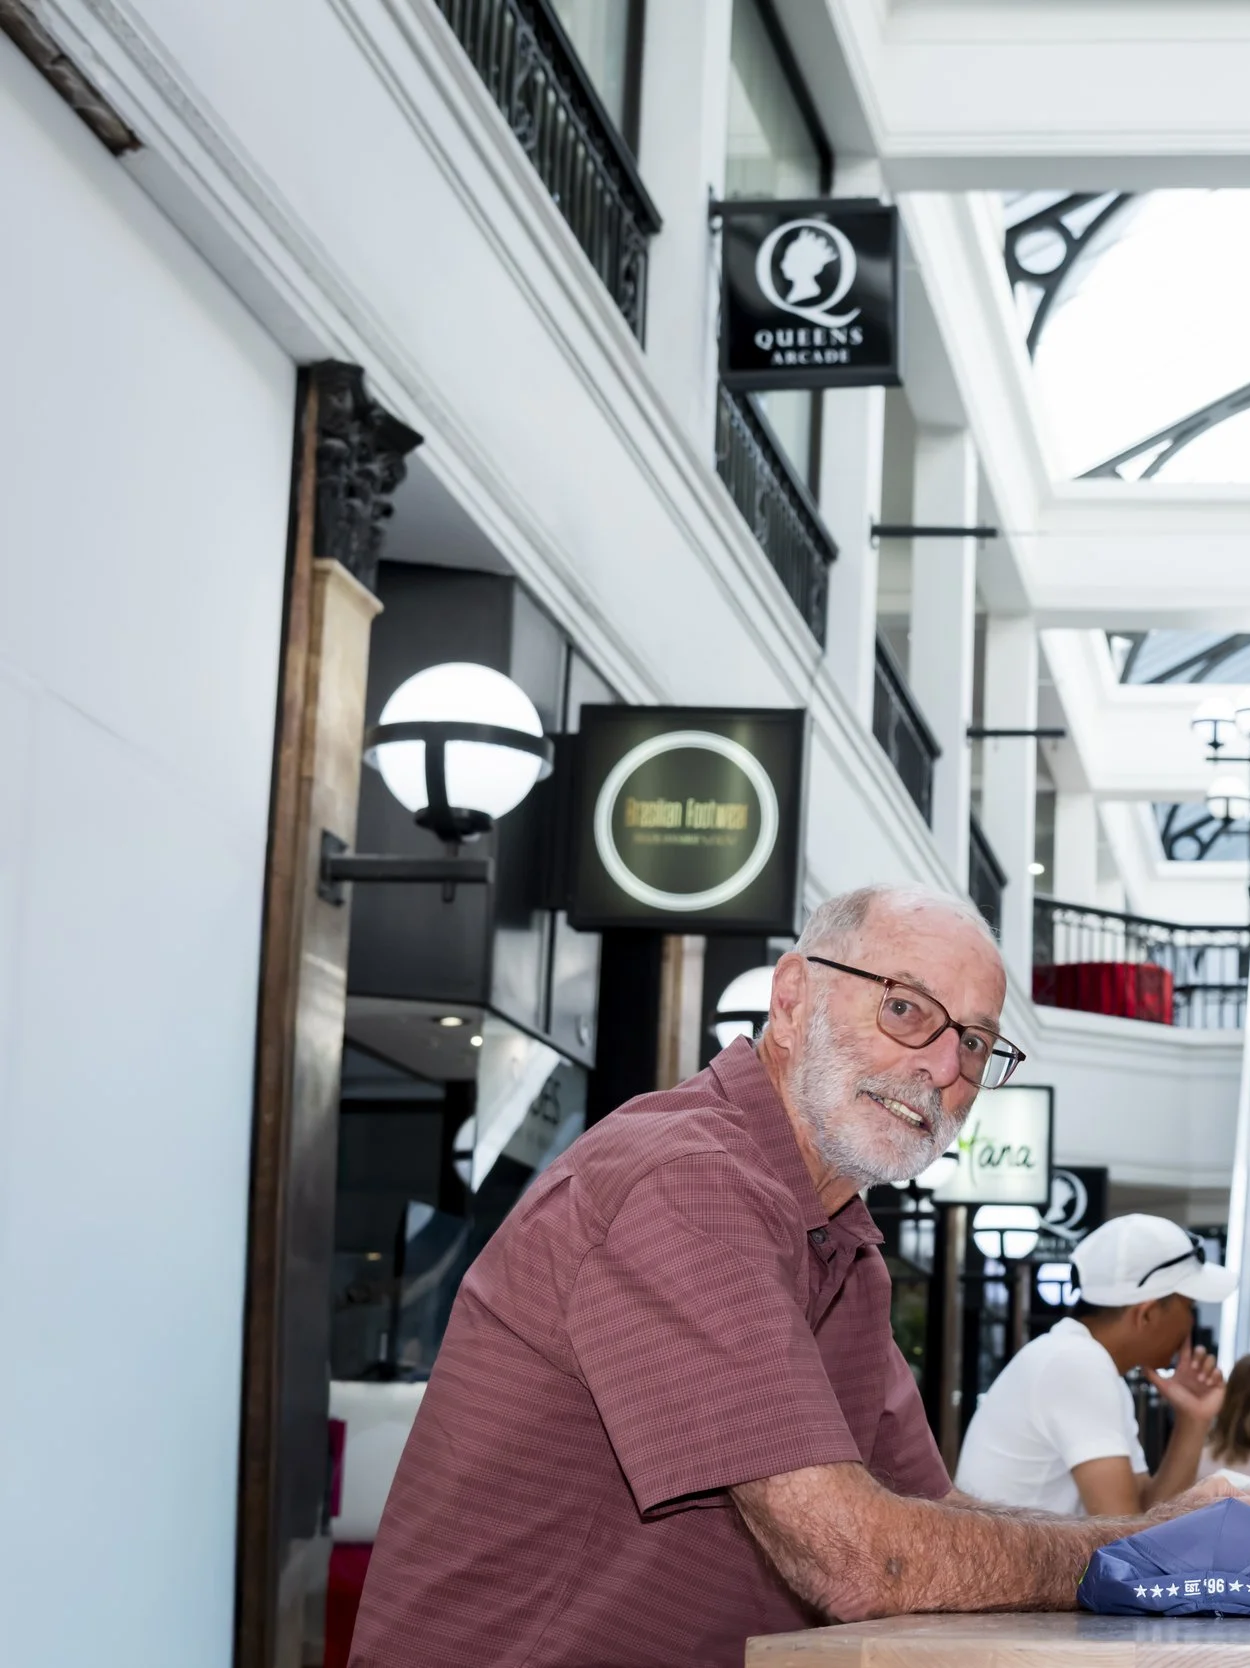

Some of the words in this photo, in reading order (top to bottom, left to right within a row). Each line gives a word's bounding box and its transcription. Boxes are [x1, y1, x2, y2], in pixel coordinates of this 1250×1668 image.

[754, 326, 863, 350] QUEENS
[771, 348, 849, 365] ARCADE
[1184, 1583, 1200, 1593] EST.
